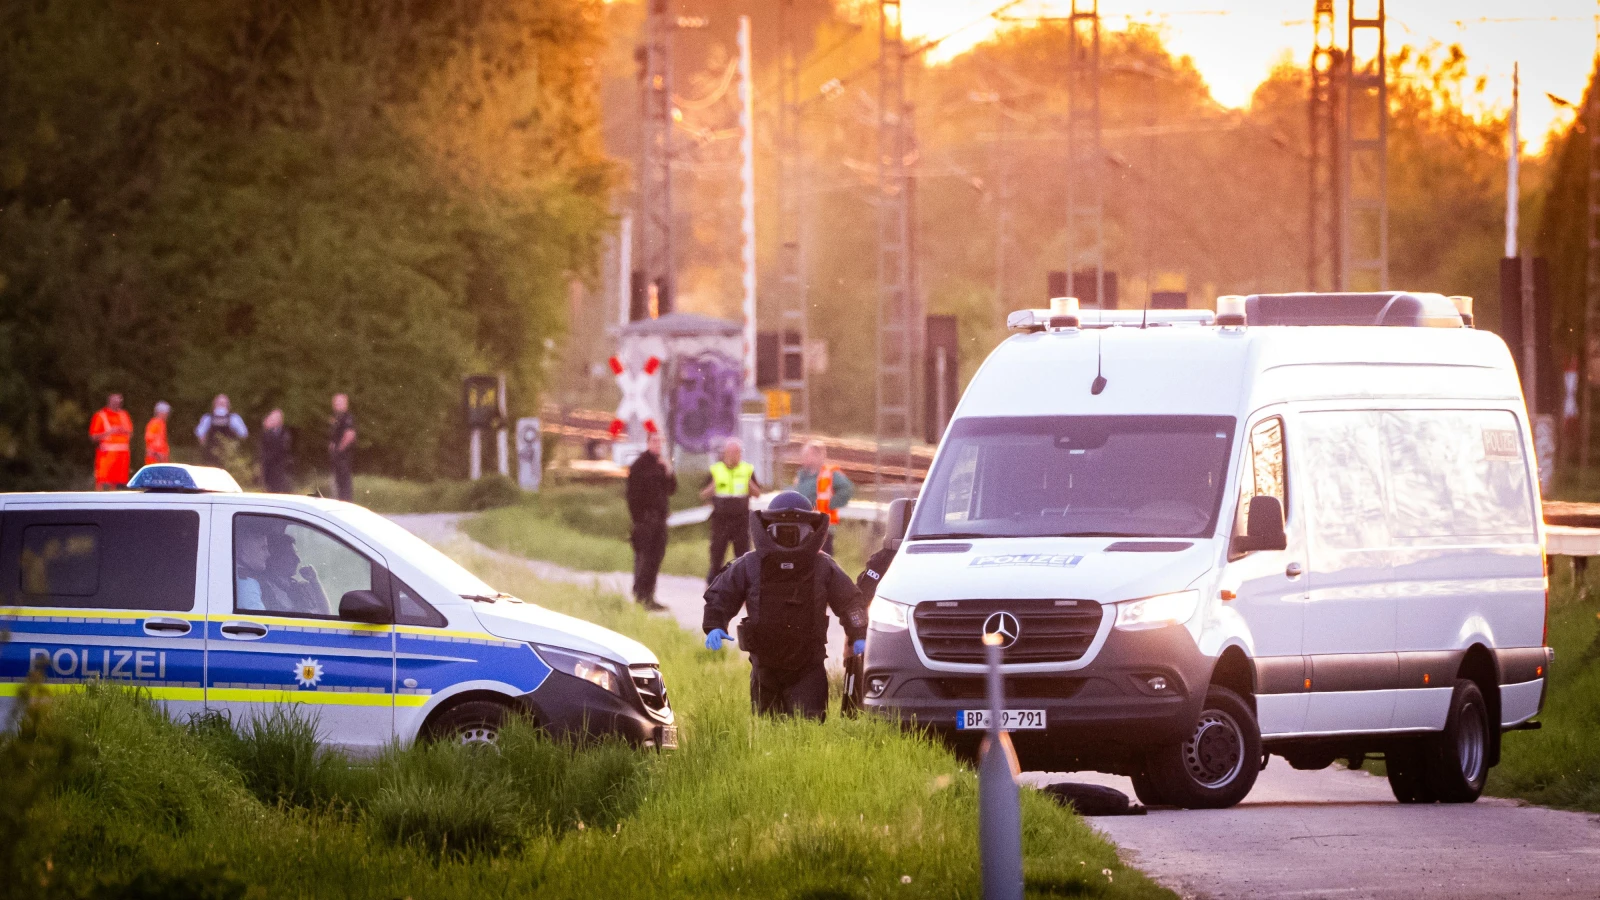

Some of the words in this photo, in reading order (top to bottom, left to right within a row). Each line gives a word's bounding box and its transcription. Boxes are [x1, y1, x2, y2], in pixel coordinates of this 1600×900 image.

[1483, 431, 1517, 452] POLIZEI
[976, 555, 1076, 565] POLIZEI
[29, 647, 166, 679] POLIZEI
[967, 711, 983, 727] BP
[995, 711, 1043, 727] 9-791
